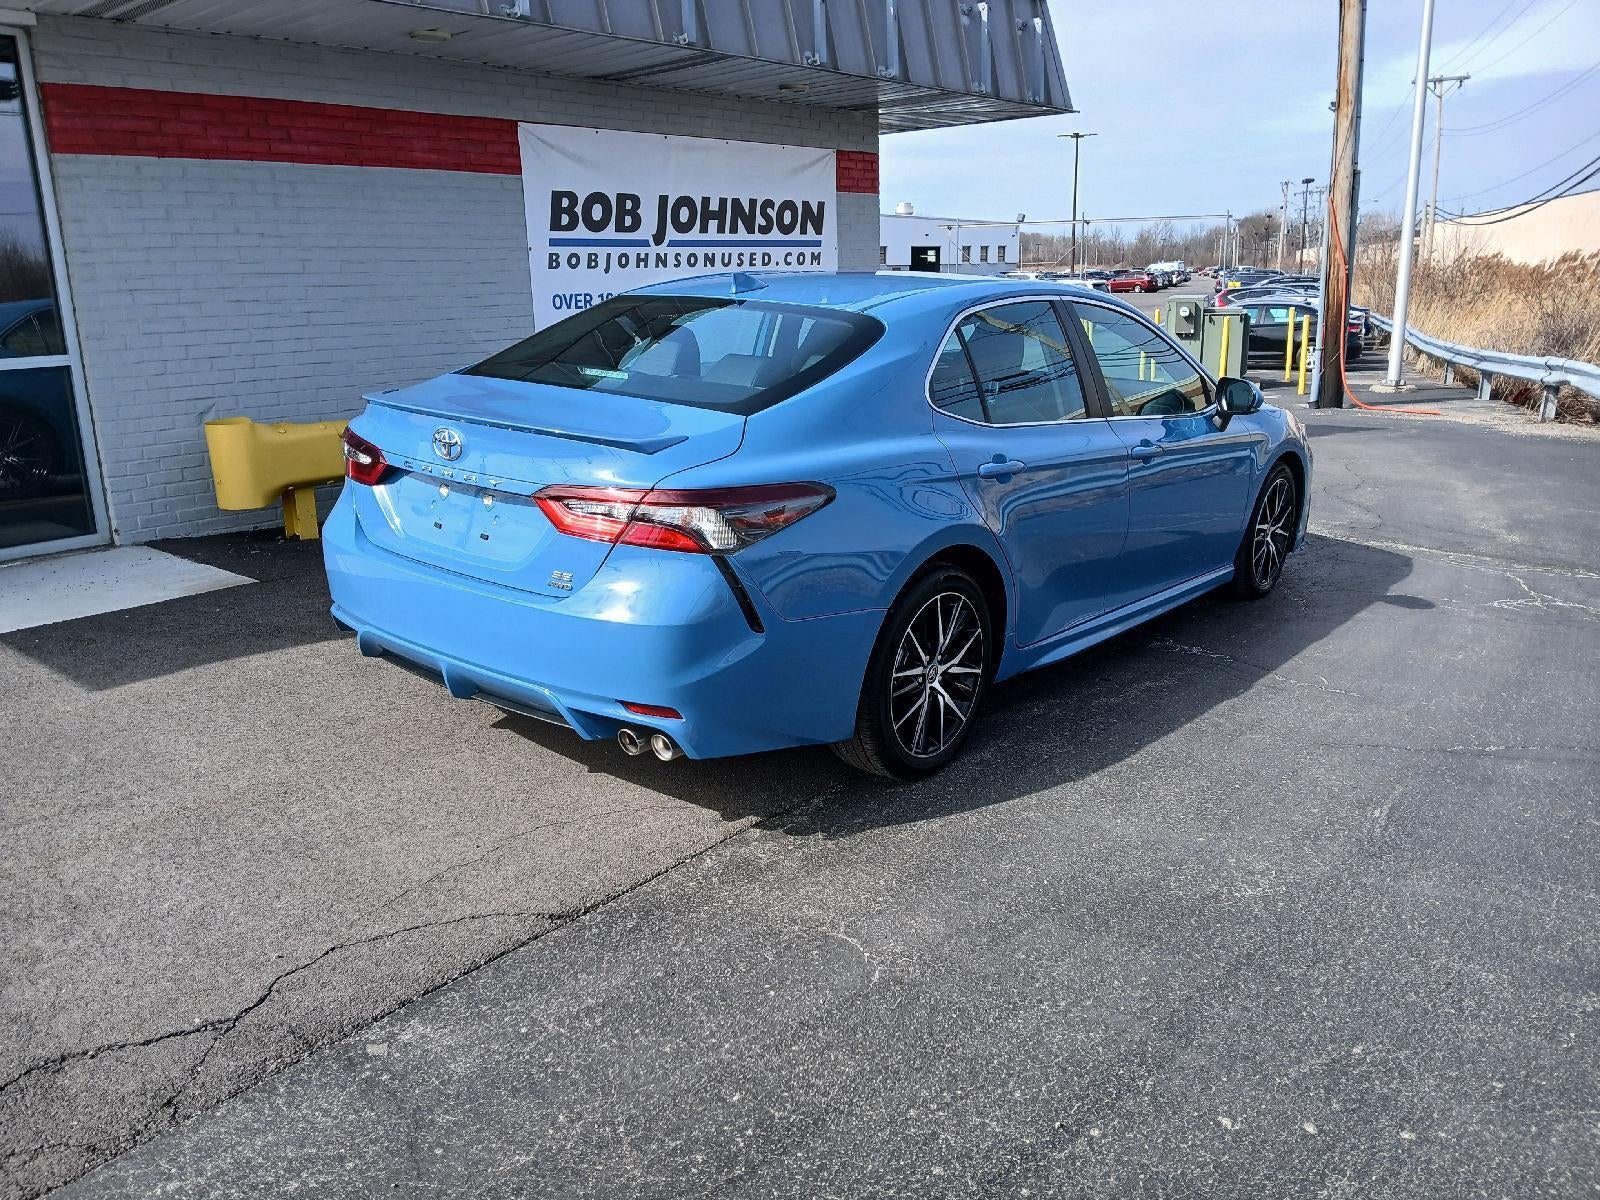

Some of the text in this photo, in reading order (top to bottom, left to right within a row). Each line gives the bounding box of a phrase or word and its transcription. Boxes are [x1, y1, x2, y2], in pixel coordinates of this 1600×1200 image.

[549, 189, 826, 247] BOB JOHNSON
[547, 250, 822, 274] BOBJOHNSONUSED.COM
[551, 292, 594, 311] OVER
[403, 460, 504, 487] CAMRY
[547, 581, 573, 591] AWD
[551, 570, 573, 582] SE
